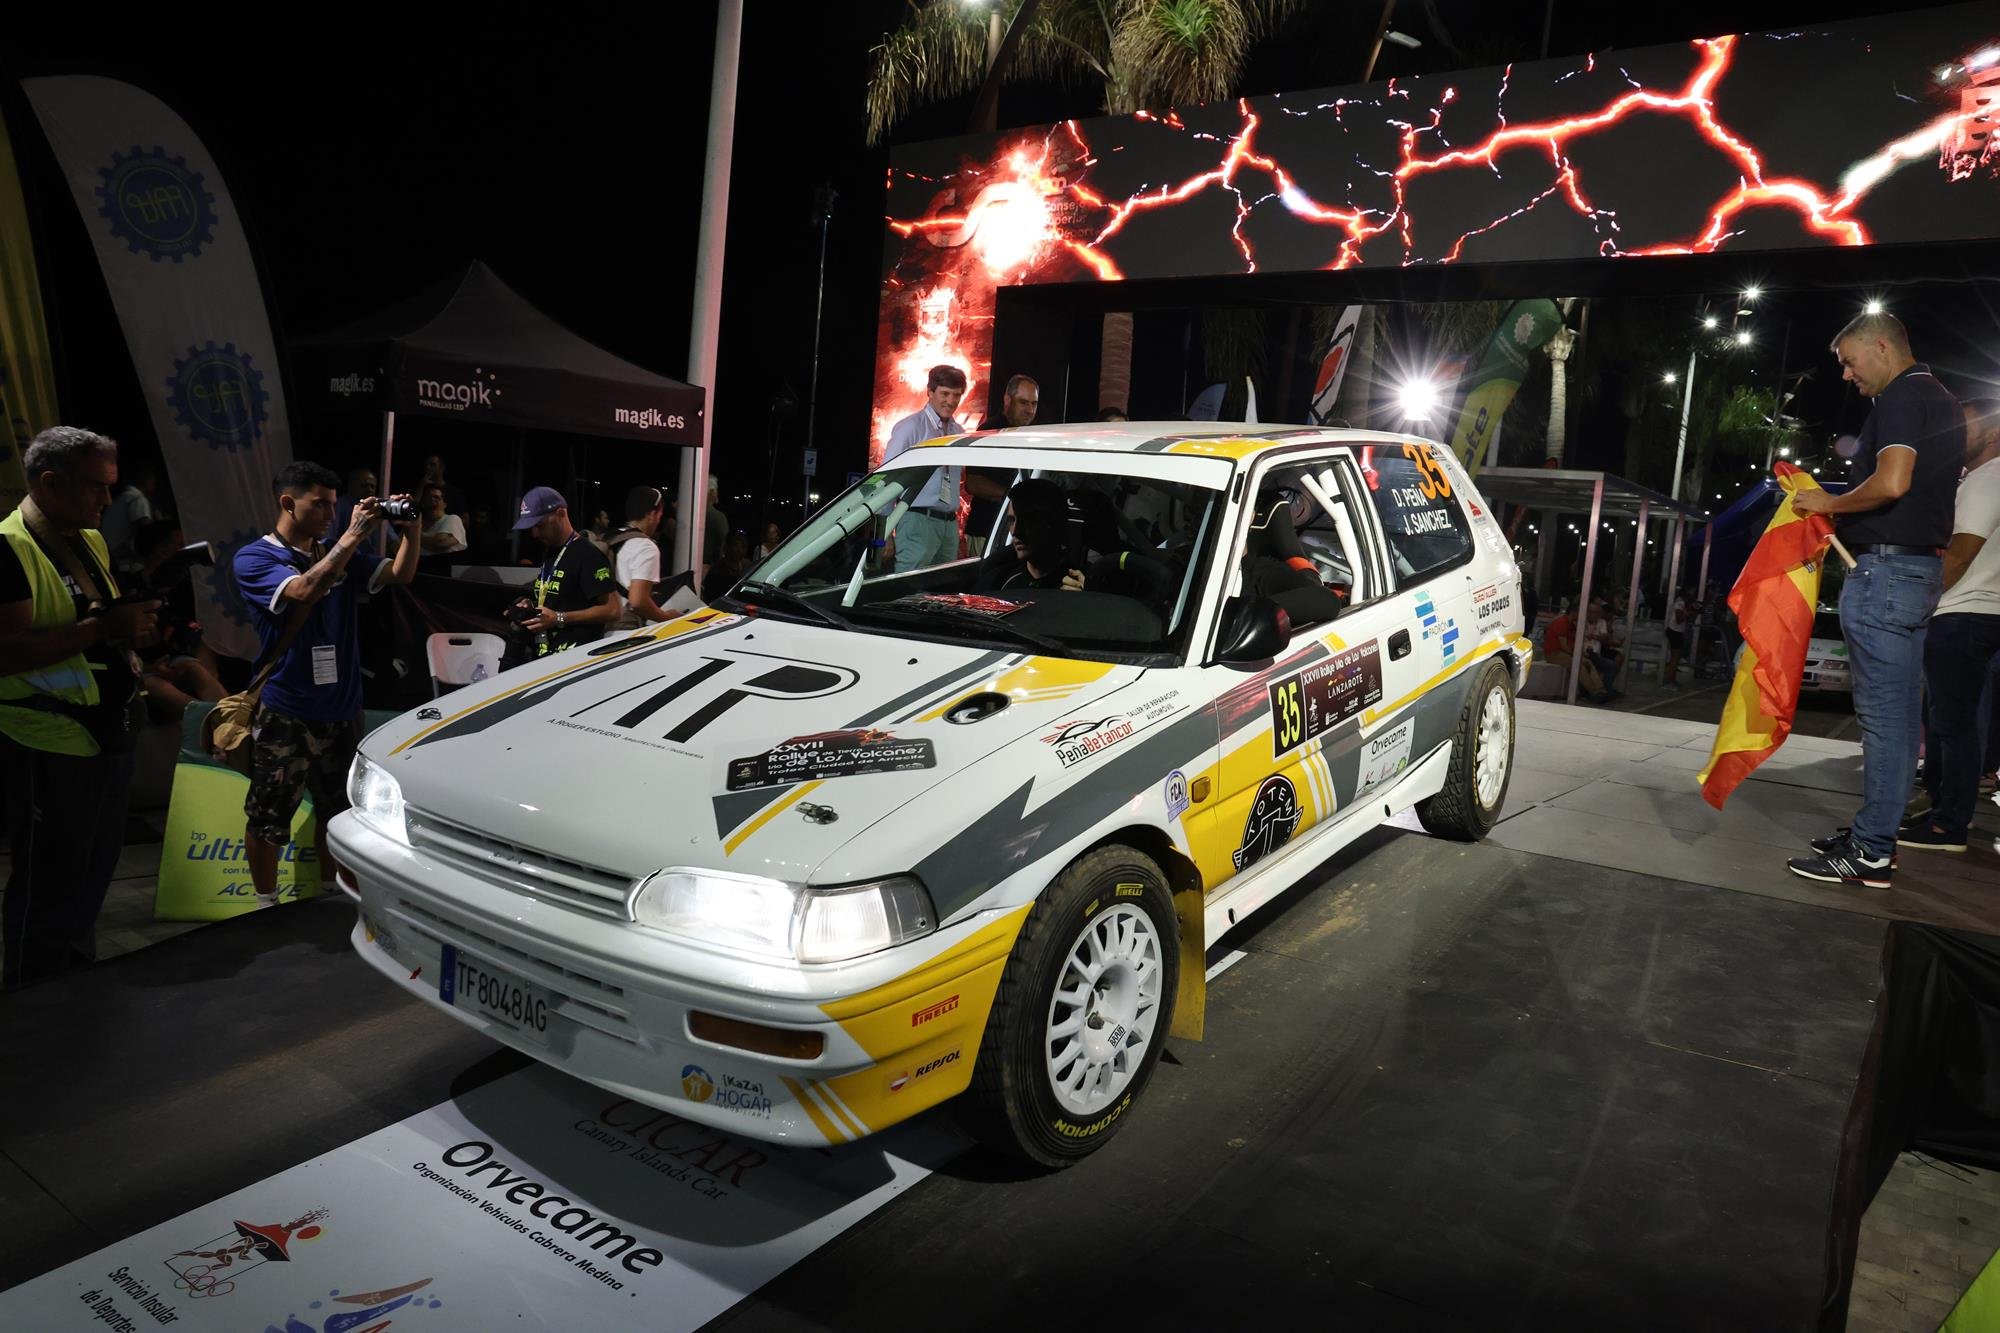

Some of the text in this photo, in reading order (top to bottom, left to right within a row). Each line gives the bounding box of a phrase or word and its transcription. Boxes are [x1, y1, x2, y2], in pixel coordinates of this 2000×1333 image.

[330, 372, 375, 398] magik.es
[417, 380, 493, 409] magik
[615, 406, 685, 429] magik.es
[1403, 442, 1451, 500] 35
[1392, 484, 1429, 508] D. PEÑA
[1403, 509, 1452, 536] J. SANCHEZ
[1478, 595, 1510, 619] LOS POZOS
[1345, 655, 1352, 665] de
[1328, 674, 1363, 699] LANZAROTE
[1126, 706, 1144, 718] TALLER
[1143, 702, 1151, 710] DE
[1278, 681, 1300, 748] 35
[769, 741, 824, 754] XXVII
[1371, 726, 1407, 755] Orvecame
[768, 750, 819, 763] Rallye
[768, 767, 805, 775] Trofeo
[809, 761, 854, 770] Ciudad
[878, 754, 926, 762] Arrecife
[786, 759, 808, 767] de
[816, 755, 843, 763] Los
[851, 747, 924, 759] Volcanes
[1170, 782, 1183, 802] FCA
[191, 830, 207, 843] bp
[222, 867, 240, 875] con
[457, 962, 547, 1032] TF8048AG
[912, 994, 960, 1027] PIRELLI
[1109, 1025, 1125, 1047] BRAID
[915, 1050, 961, 1078] REPSOL
[716, 1087, 772, 1114] HOGAR
[1054, 1092, 1132, 1138] SCORPION
[600, 1099, 769, 1188] CICAR
[575, 1119, 728, 1200] Canary Islands Car
[442, 1140, 664, 1275] Orvecame
[413, 1162, 624, 1291] Organización Vehículos Cabrera Medina
[107, 1266, 179, 1326] Servicio Insular
[80, 1289, 136, 1333] de Deportes
